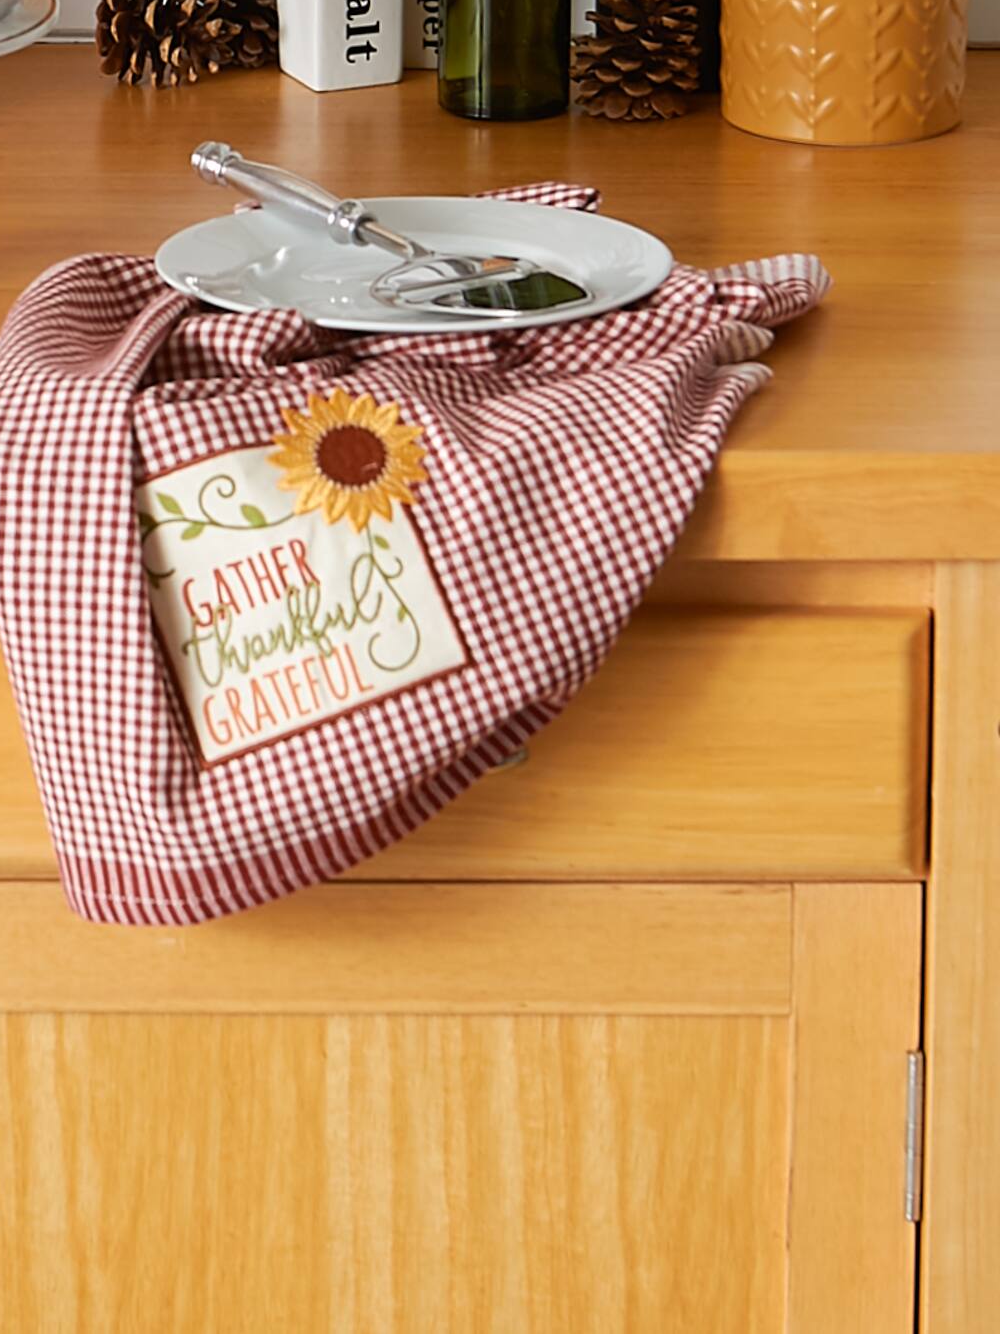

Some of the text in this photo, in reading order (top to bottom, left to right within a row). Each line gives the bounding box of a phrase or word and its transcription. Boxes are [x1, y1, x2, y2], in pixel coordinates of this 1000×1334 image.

[181, 553, 383, 688] thankful
[182, 538, 321, 628] GATHER
[202, 643, 375, 747] GRATEFUL
